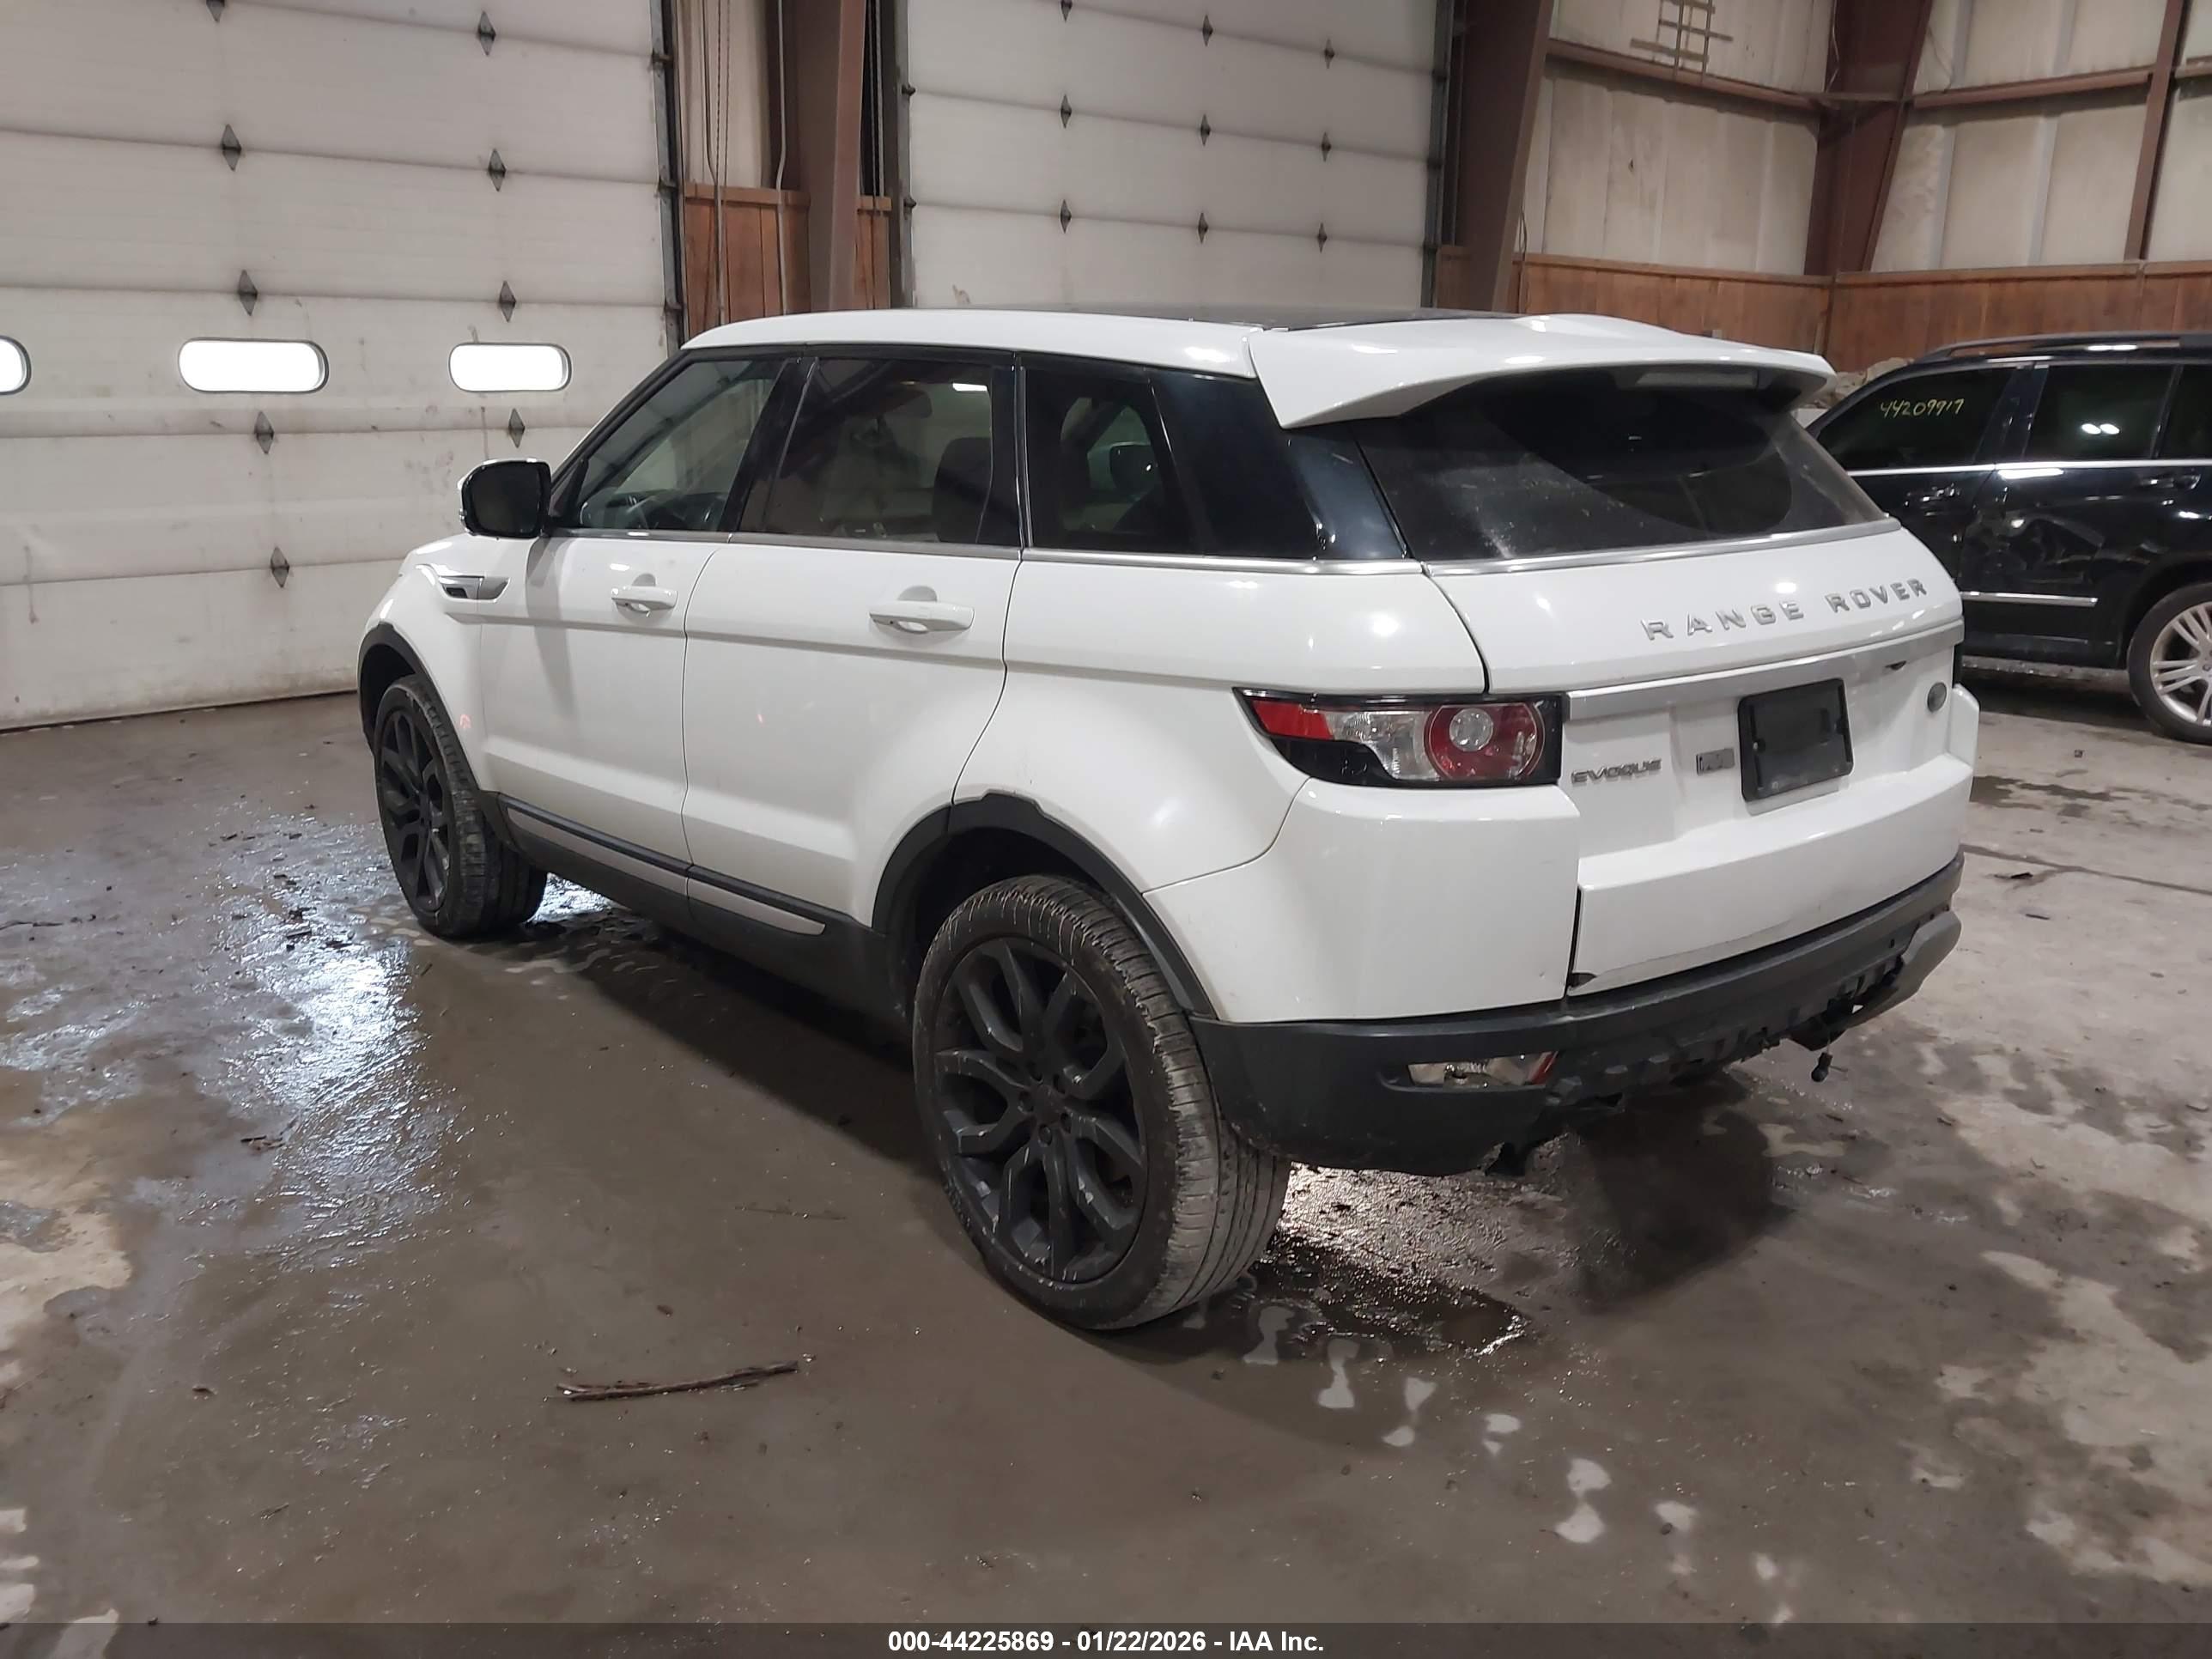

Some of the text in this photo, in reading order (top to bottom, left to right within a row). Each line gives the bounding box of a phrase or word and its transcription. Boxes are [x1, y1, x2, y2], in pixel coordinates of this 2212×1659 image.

[1880, 398, 1965, 418] 44209917
[1641, 578, 1929, 641] RANGE ROVER
[1571, 758, 1662, 785] EVOQUE
